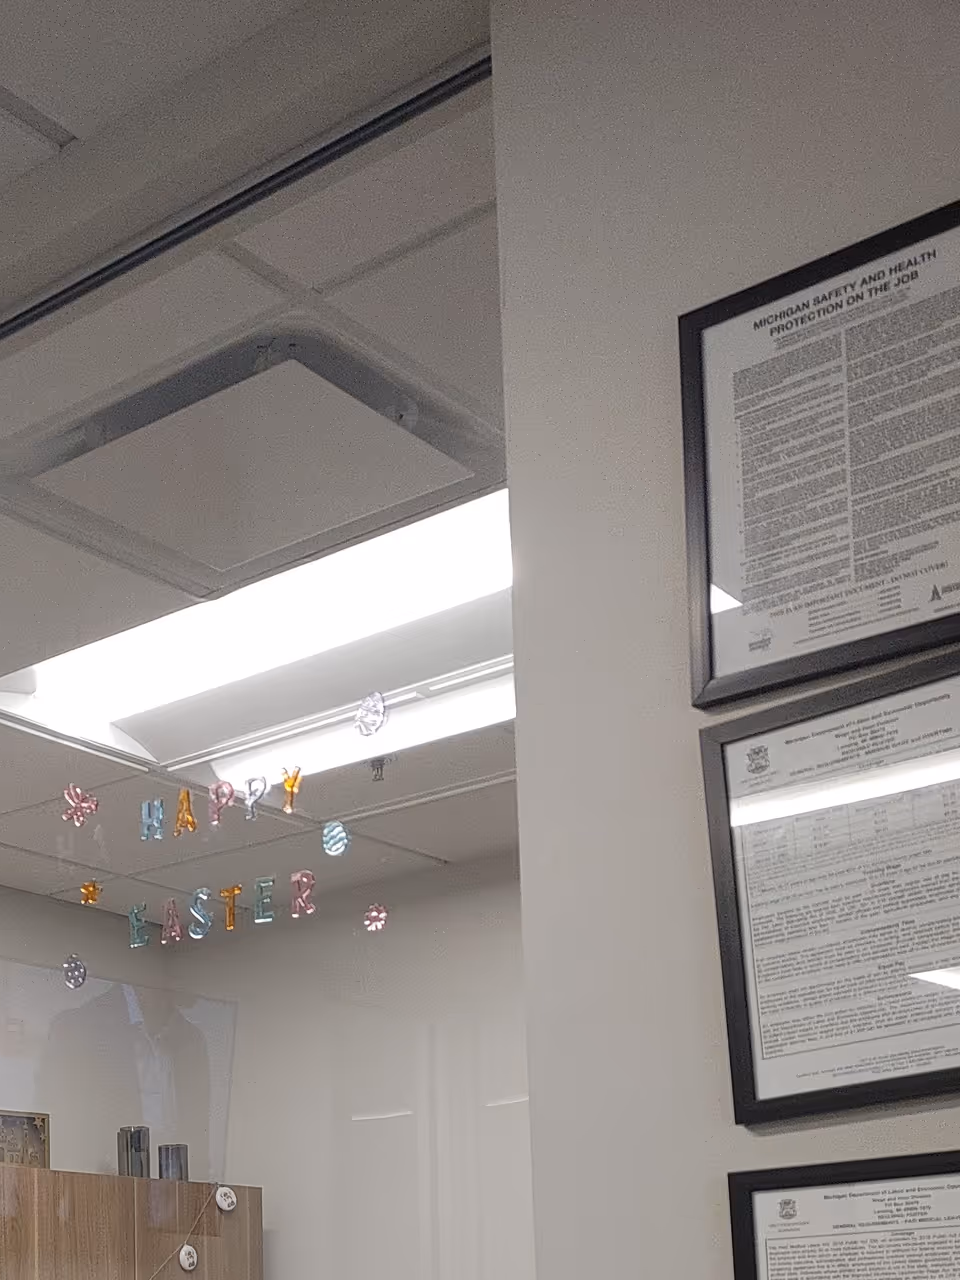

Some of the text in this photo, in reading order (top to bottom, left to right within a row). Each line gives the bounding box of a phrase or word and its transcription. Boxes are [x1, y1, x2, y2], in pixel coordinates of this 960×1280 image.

[753, 300, 810, 331] MICHIGAN
[813, 280, 857, 307] SAFETY
[860, 269, 886, 288] AND
[889, 249, 937, 277] HEALTH
[769, 269, 919, 337] PROTECTION ON THE JOB
[139, 765, 303, 842] HAPPY
[127, 868, 317, 950] EASTER
